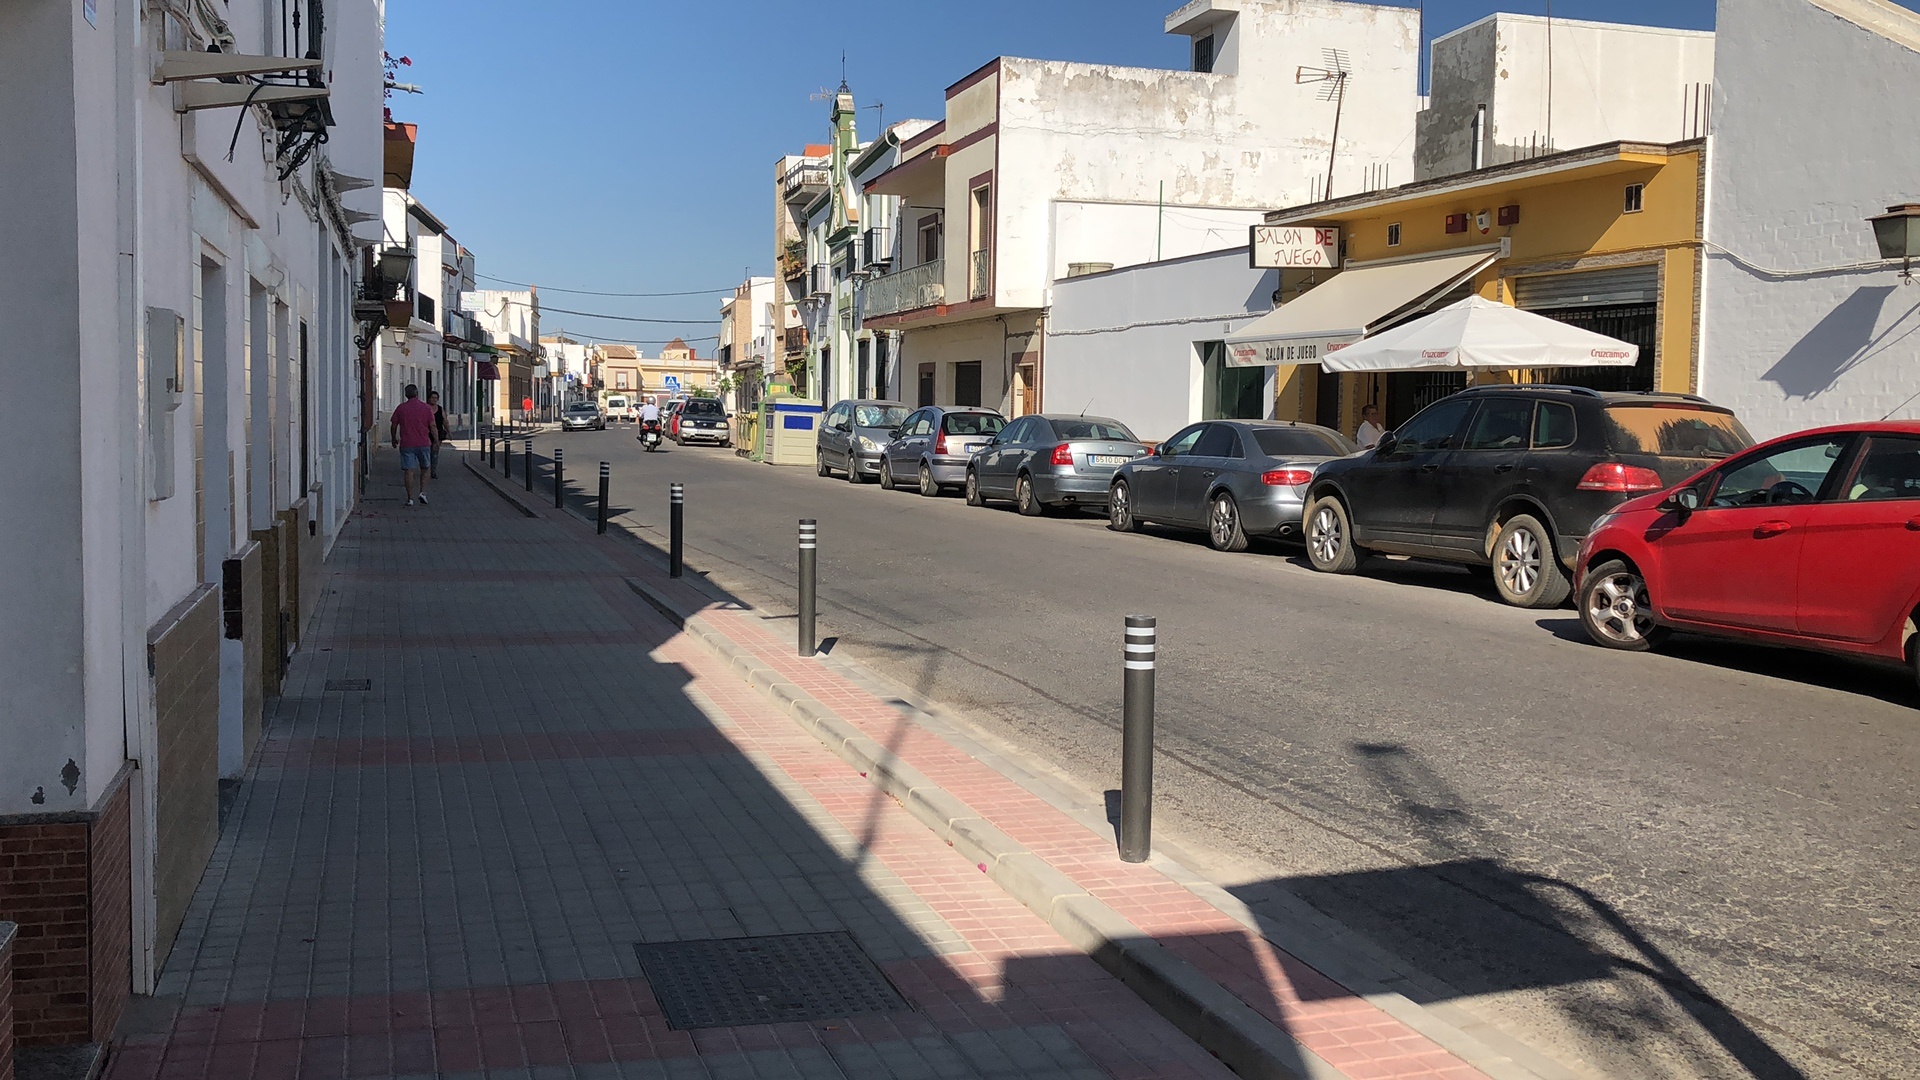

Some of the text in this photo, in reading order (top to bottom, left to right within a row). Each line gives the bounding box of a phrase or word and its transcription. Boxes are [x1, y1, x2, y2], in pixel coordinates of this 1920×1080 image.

[1257, 227, 1334, 246] SALON DE
[1274, 249, 1322, 265] JUEGO
[1265, 344, 1317, 361] SALÓN DE JUEGO
[1590, 348, 1630, 359] Cruzcampo
